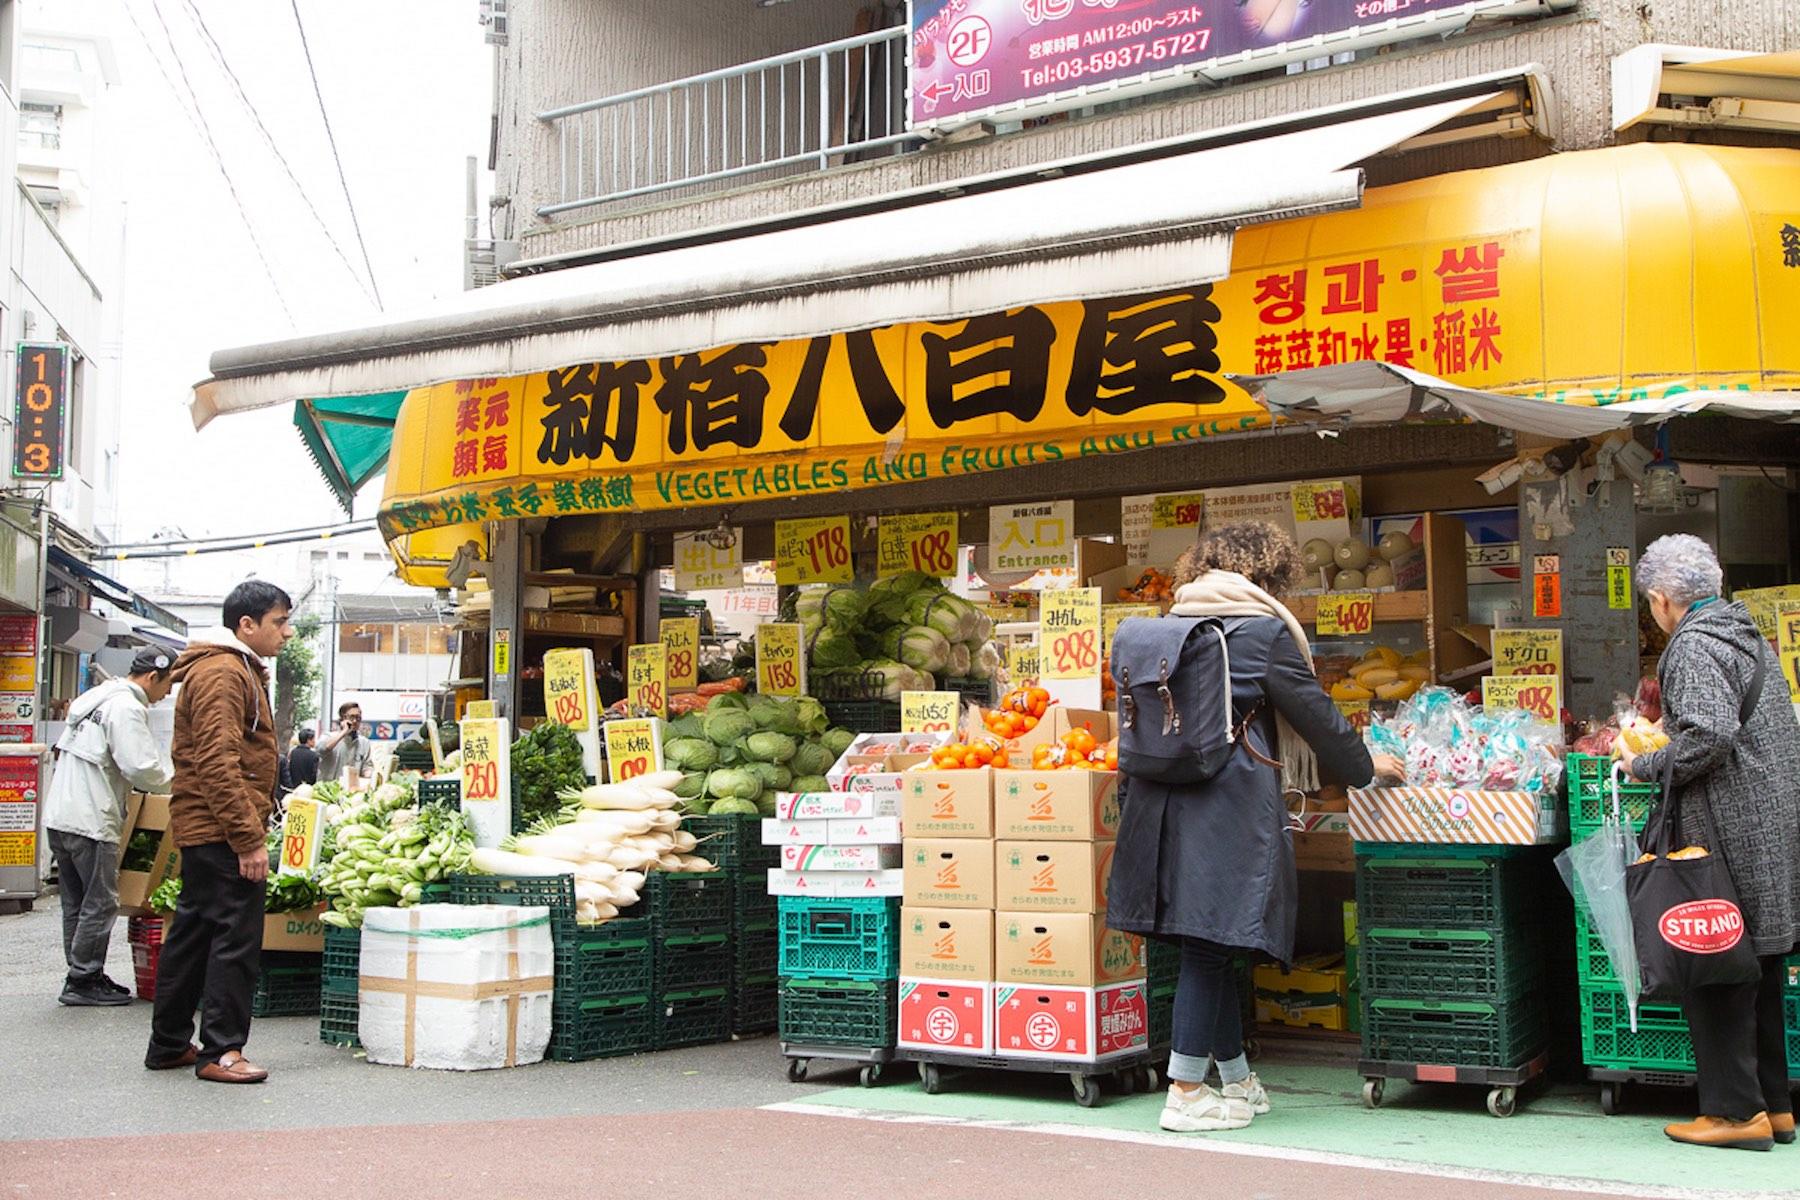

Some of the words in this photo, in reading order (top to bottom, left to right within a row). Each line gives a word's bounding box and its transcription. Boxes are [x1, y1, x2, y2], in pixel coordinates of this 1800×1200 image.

[952, 27, 987, 58] 2F
[1020, 29, 1211, 88] Tel:03-5937-5727
[952, 69, 990, 101] 入口
[537, 283, 1227, 466] 新宿八百屋
[655, 459, 849, 503] VEGETABLES
[863, 452, 928, 483] AND
[940, 438, 1065, 475] FRUITS
[999, 518, 1065, 551] 入口
[810, 526, 849, 575] 178
[911, 529, 953, 573] 198
[997, 553, 1068, 568] Entrance
[696, 573, 724, 587] Exit
[1046, 608, 1082, 627] みかん
[667, 650, 692, 681] 38
[1053, 629, 1097, 673] 298
[1503, 647, 1548, 662] ザクロ
[633, 664, 655, 682] なす
[767, 660, 797, 691] 158
[555, 692, 583, 724] 128
[637, 680, 663, 710] 128
[921, 701, 955, 720] いちご
[1517, 686, 1554, 719] 198
[465, 761, 499, 799] 250
[1666, 911, 1741, 937] STRAND
